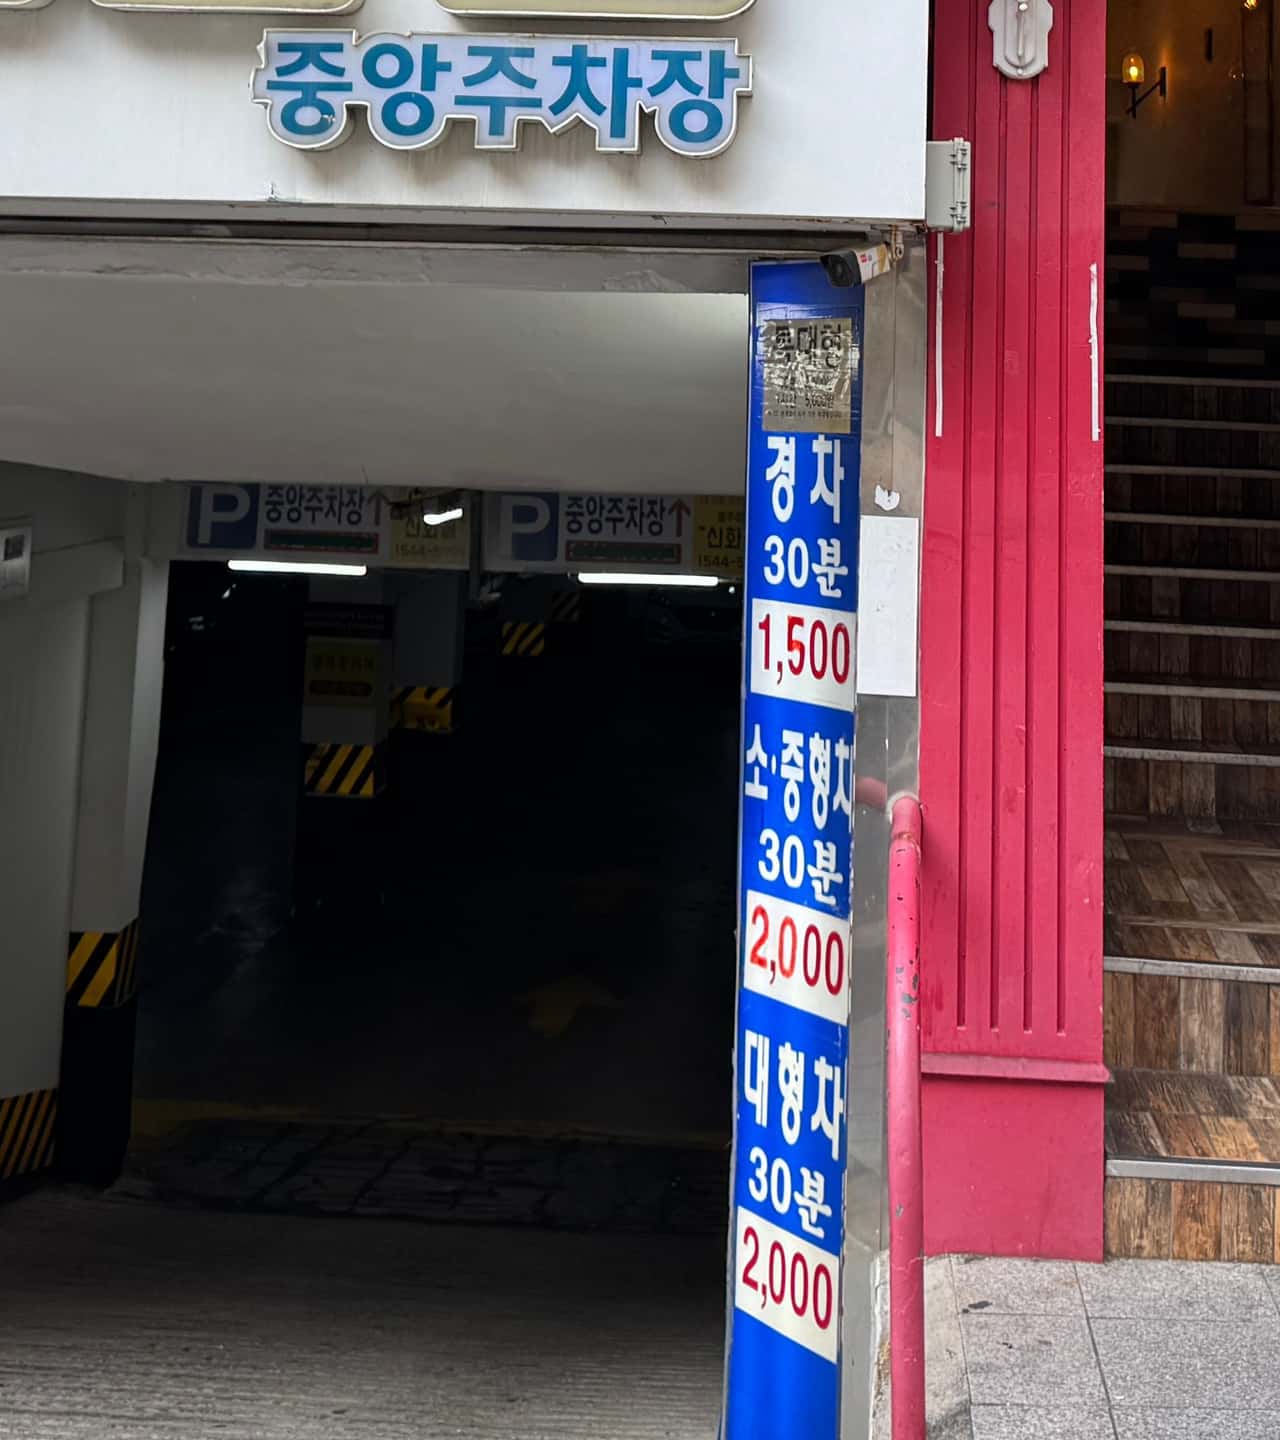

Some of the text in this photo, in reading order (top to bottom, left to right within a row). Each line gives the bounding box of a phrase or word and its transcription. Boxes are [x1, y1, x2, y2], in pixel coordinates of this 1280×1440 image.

[265, 39, 740, 152] 중앙주차장
[264, 484, 366, 526] 중앙주차장
[565, 495, 667, 537] 중앙주차장
[763, 535, 849, 600] 30분
[758, 611, 851, 687] 1,500
[757, 827, 844, 907] 30분
[750, 904, 845, 997] 2,000
[743, 1026, 845, 1161] 대형차
[747, 1145, 833, 1239] 30분
[741, 1225, 834, 1332] 2,000
